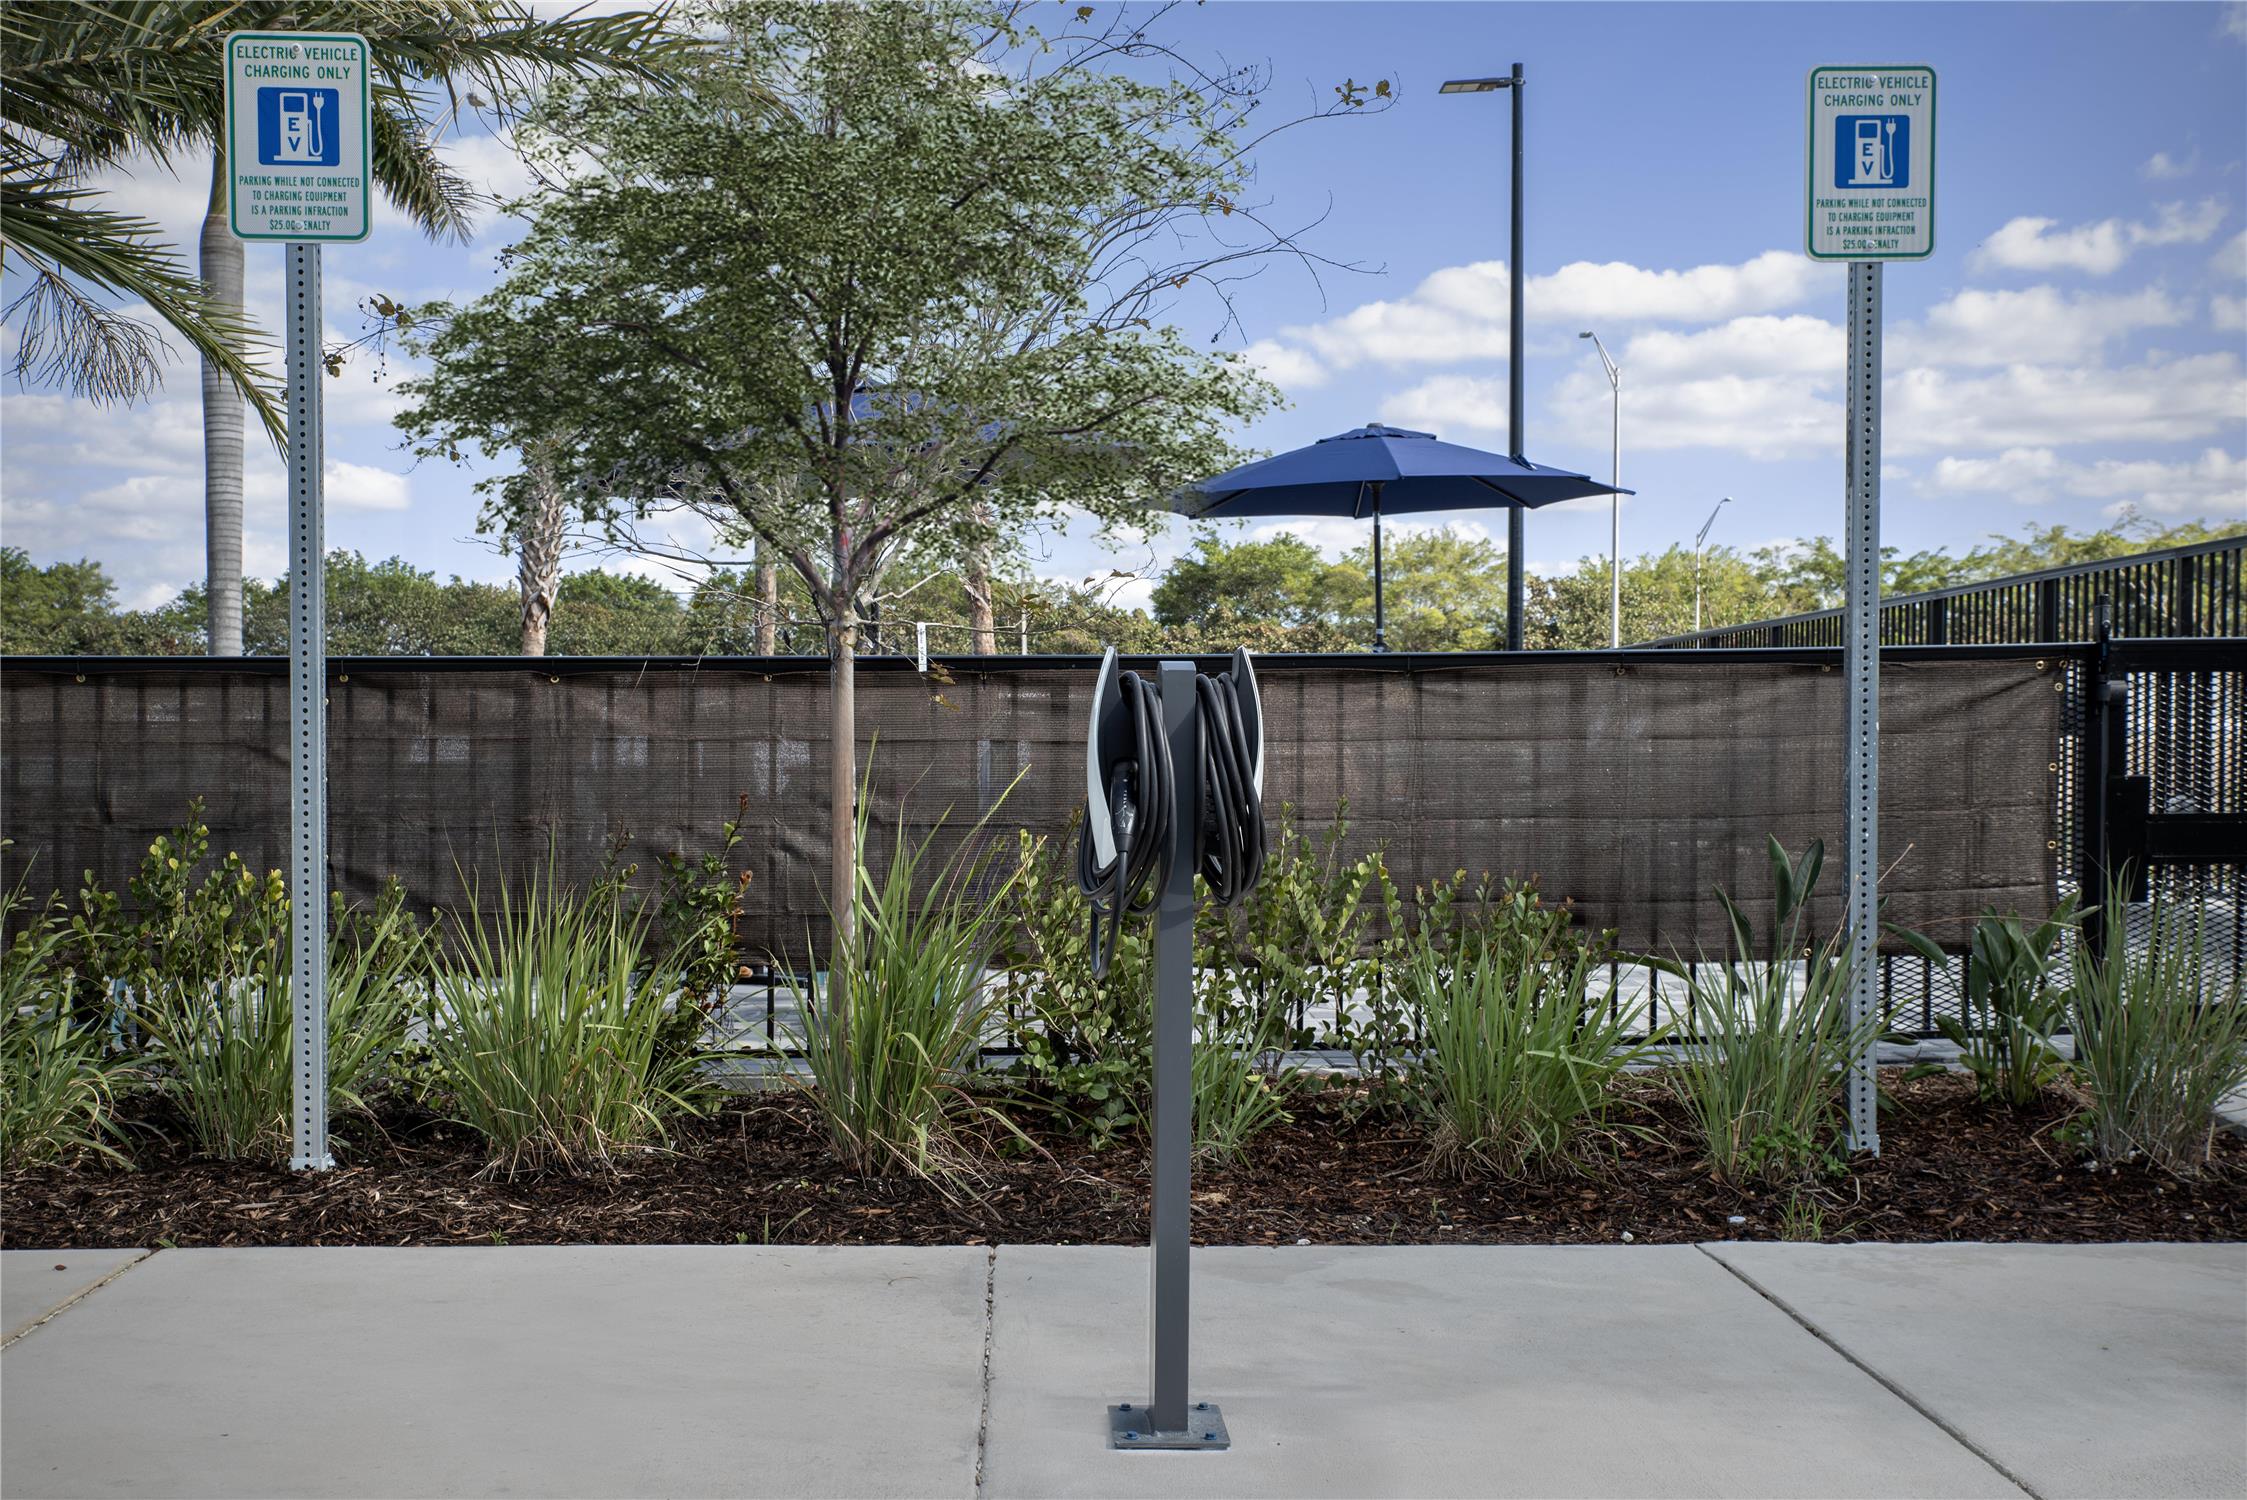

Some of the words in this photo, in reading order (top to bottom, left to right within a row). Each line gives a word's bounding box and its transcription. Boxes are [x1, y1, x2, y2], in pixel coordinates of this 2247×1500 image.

[237, 45, 298, 59] ELECTRIC
[304, 47, 358, 61] VEHICLE
[244, 65, 310, 79] CHARGING
[317, 66, 351, 79] ONLY
[1818, 77, 1873, 90] ELECTRIC
[1879, 76, 1928, 89] VEHICLE
[1824, 94, 1884, 106] CHARGING
[1890, 94, 1922, 106] ONLY
[288, 117, 301, 152] EV
[1862, 143, 1874, 176] EV
[239, 175, 272, 186] PARKING
[274, 176, 297, 187] WHILE
[300, 176, 314, 187] NOT
[317, 176, 360, 188] CONNECTED
[252, 190, 262, 200] TO
[264, 190, 302, 201] CHARGING
[305, 191, 347, 202] EQUIPMENT
[1816, 198, 1846, 209] PARKING
[1848, 198, 1870, 208] WHILE
[1872, 198, 1885, 208] NOT
[1887, 198, 1927, 208] CONNECTED
[251, 205, 259, 215] IS
[261, 205, 267, 215] A
[269, 205, 302, 216] PARKING
[305, 206, 348, 217] INFRACTION
[1828, 212, 1837, 222] TO
[1838, 212, 1873, 222] CHARGING
[1876, 211, 1915, 222] EQUIPMENT
[299, 220, 331, 231] ENALTY
[1826, 226, 1834, 236] IS
[1835, 226, 1841, 236] A
[1843, 225, 1873, 236] PARKING
[1875, 225, 1916, 235] INFRACTION
[1870, 239, 1900, 250] ENALTY
